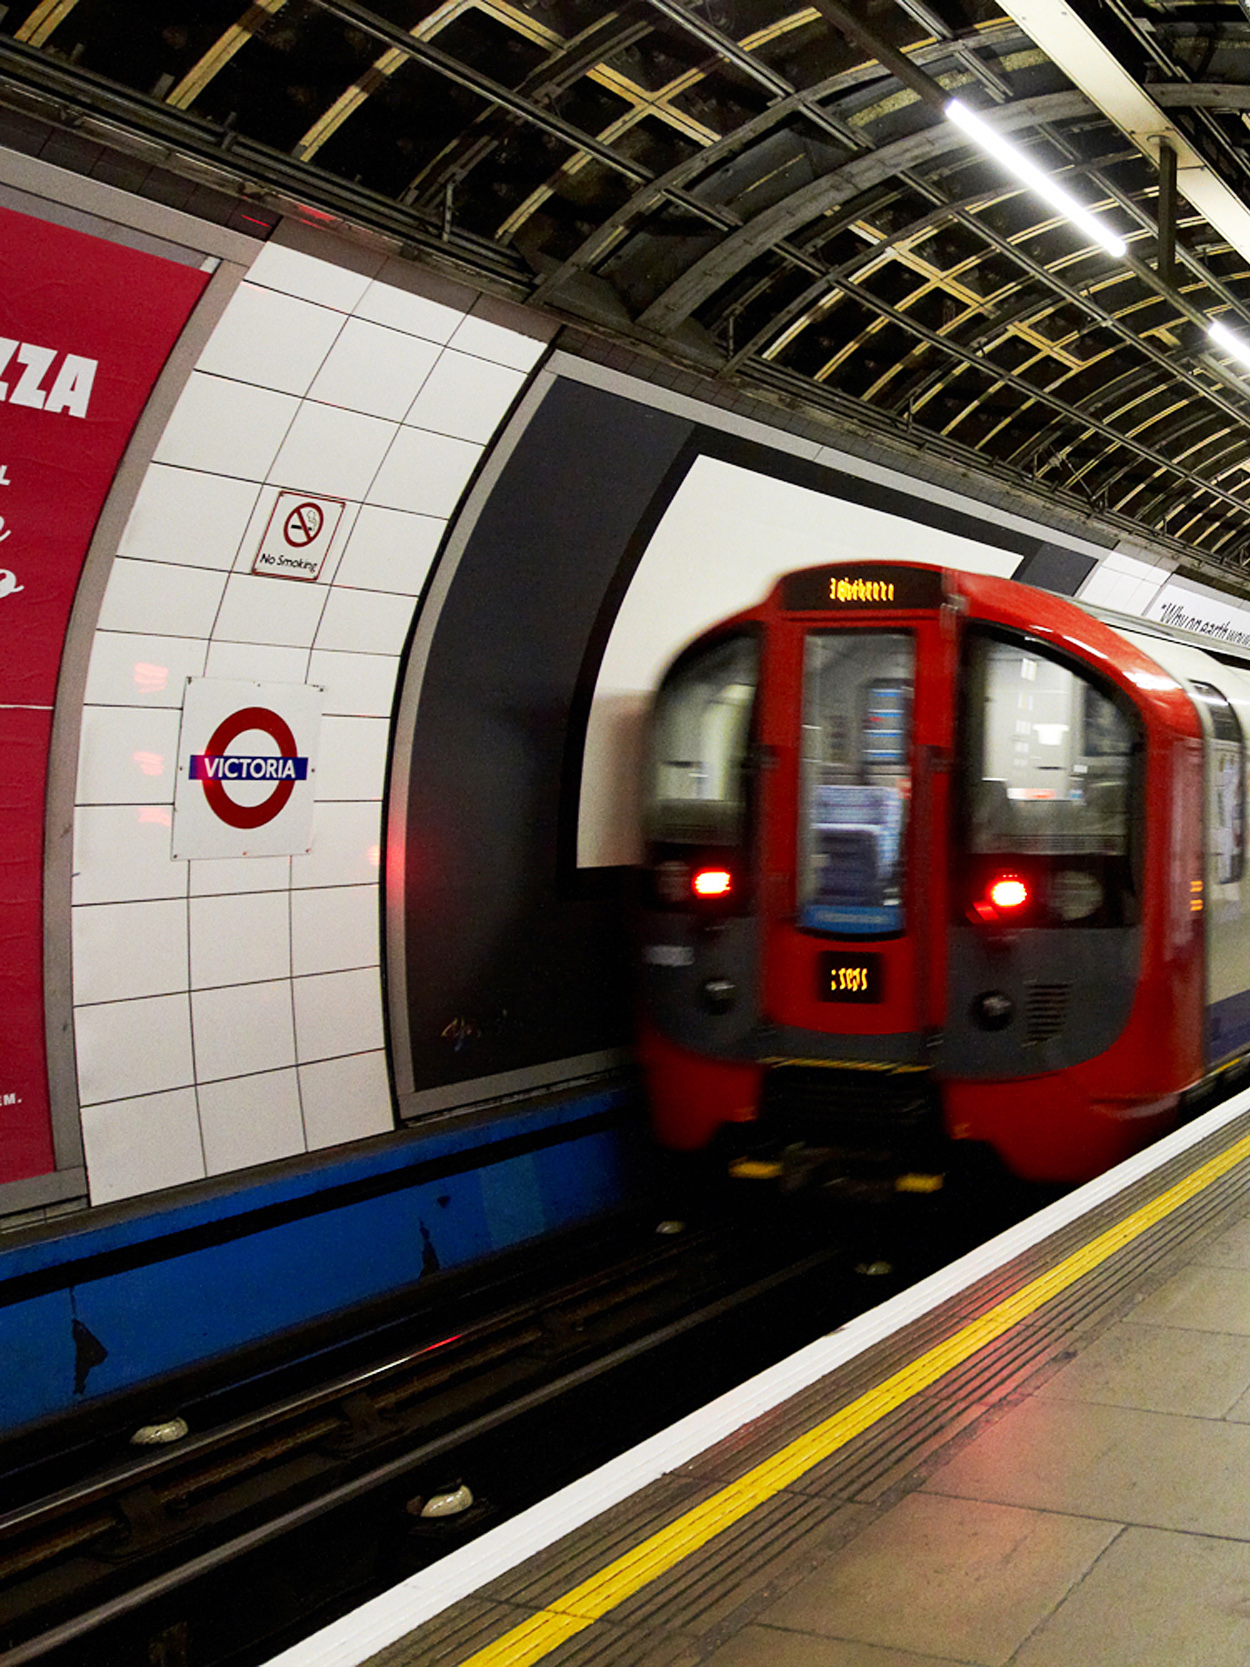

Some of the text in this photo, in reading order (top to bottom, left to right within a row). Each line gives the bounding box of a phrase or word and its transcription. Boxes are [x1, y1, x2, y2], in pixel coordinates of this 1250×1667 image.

[260, 553, 318, 573] No Smoking
[1200, 621, 1231, 640] earth
[204, 758, 296, 778] VICTORIA
